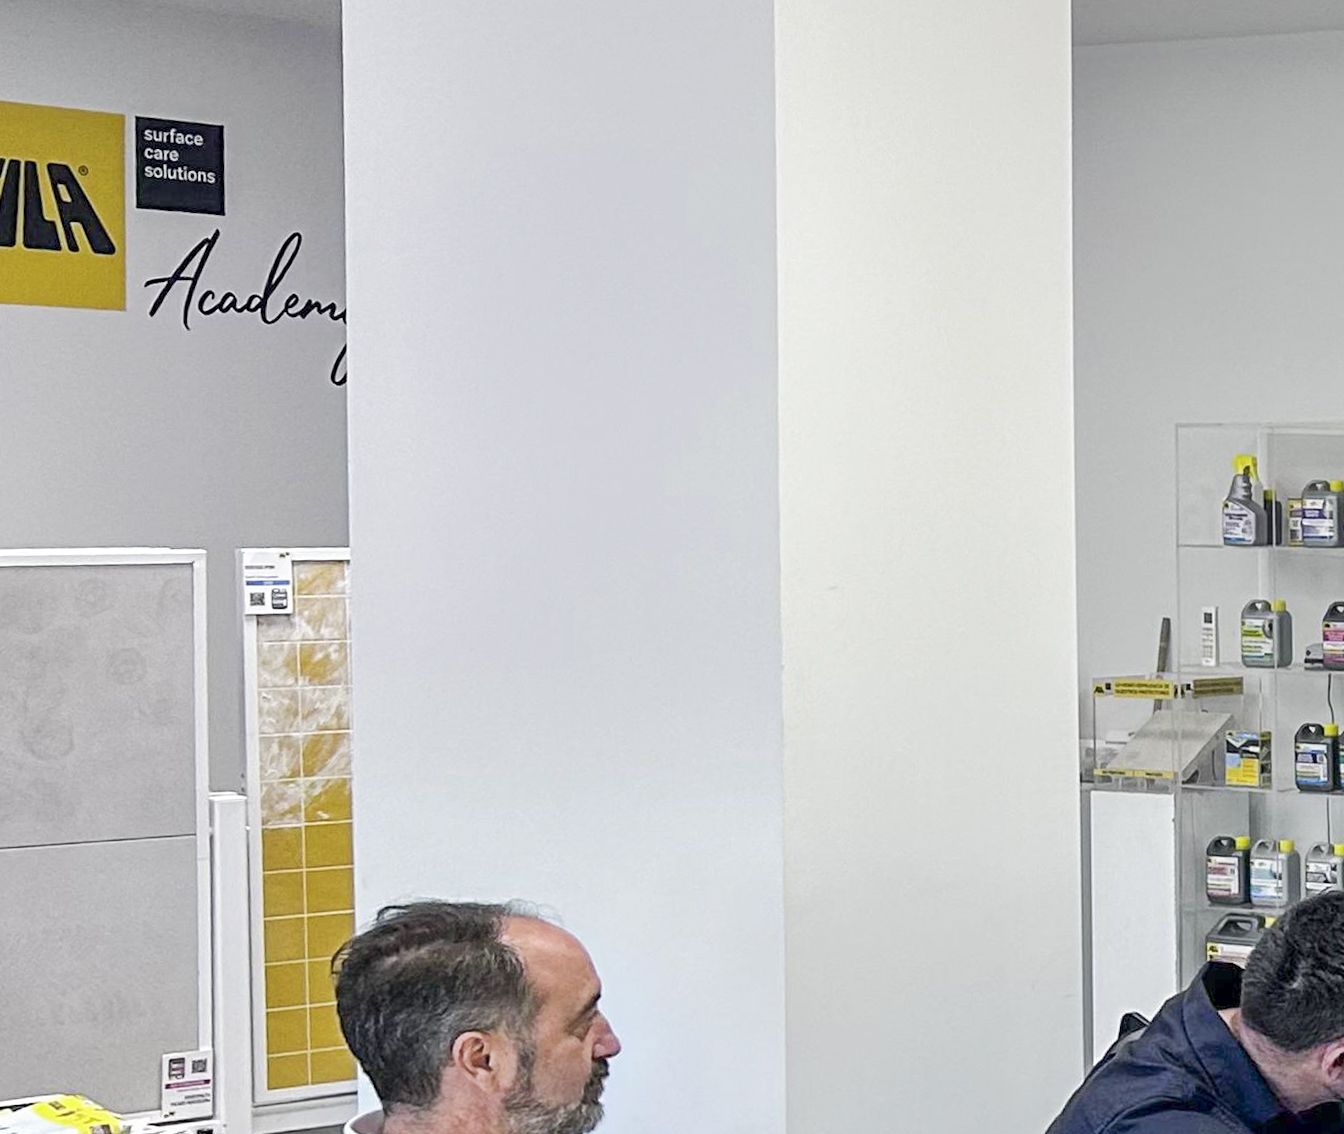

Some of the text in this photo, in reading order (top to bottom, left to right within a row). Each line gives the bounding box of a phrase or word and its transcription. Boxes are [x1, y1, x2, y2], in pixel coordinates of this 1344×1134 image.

[144, 128, 204, 146] surface
[144, 147, 179, 162] care
[144, 164, 216, 184] solutions
[0, 158, 116, 255] ILA
